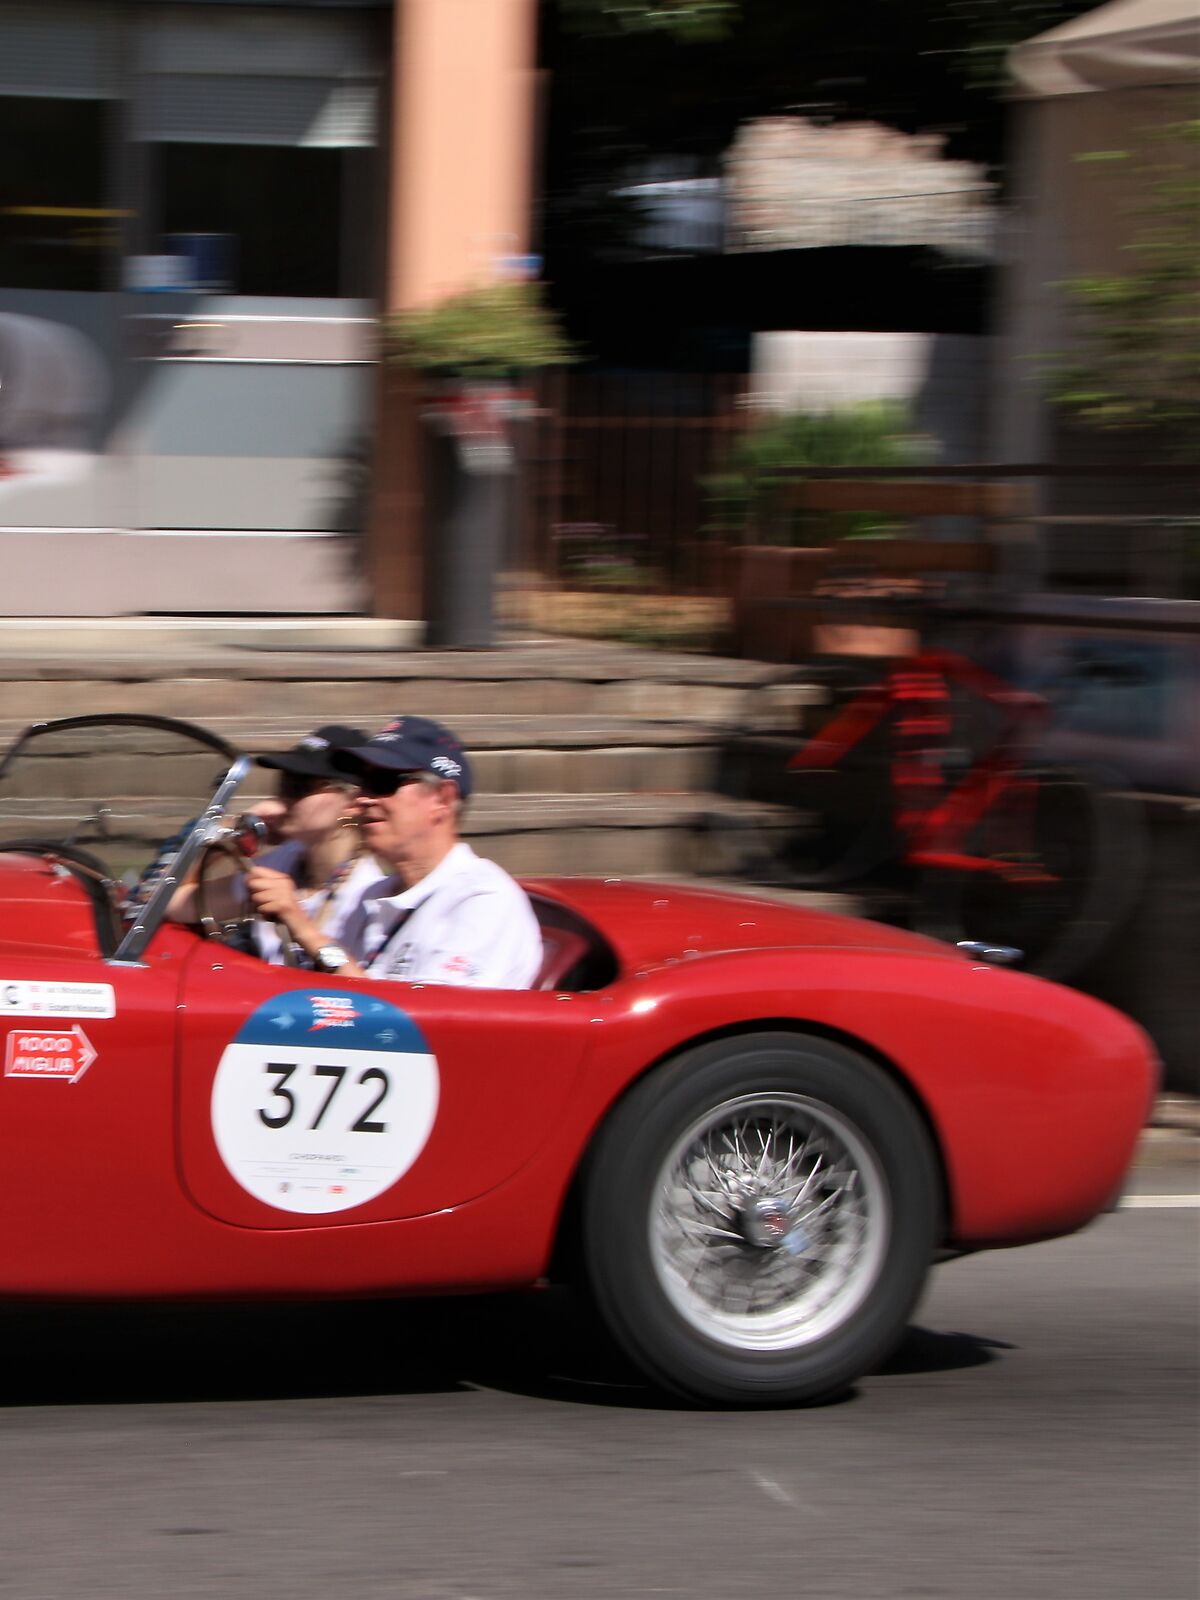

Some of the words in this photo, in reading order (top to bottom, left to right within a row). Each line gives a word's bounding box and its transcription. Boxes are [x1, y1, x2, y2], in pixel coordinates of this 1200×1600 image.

[3, 984, 21, 1005] C
[17, 1036, 73, 1052] 1000
[255, 1062, 390, 1133] 372
